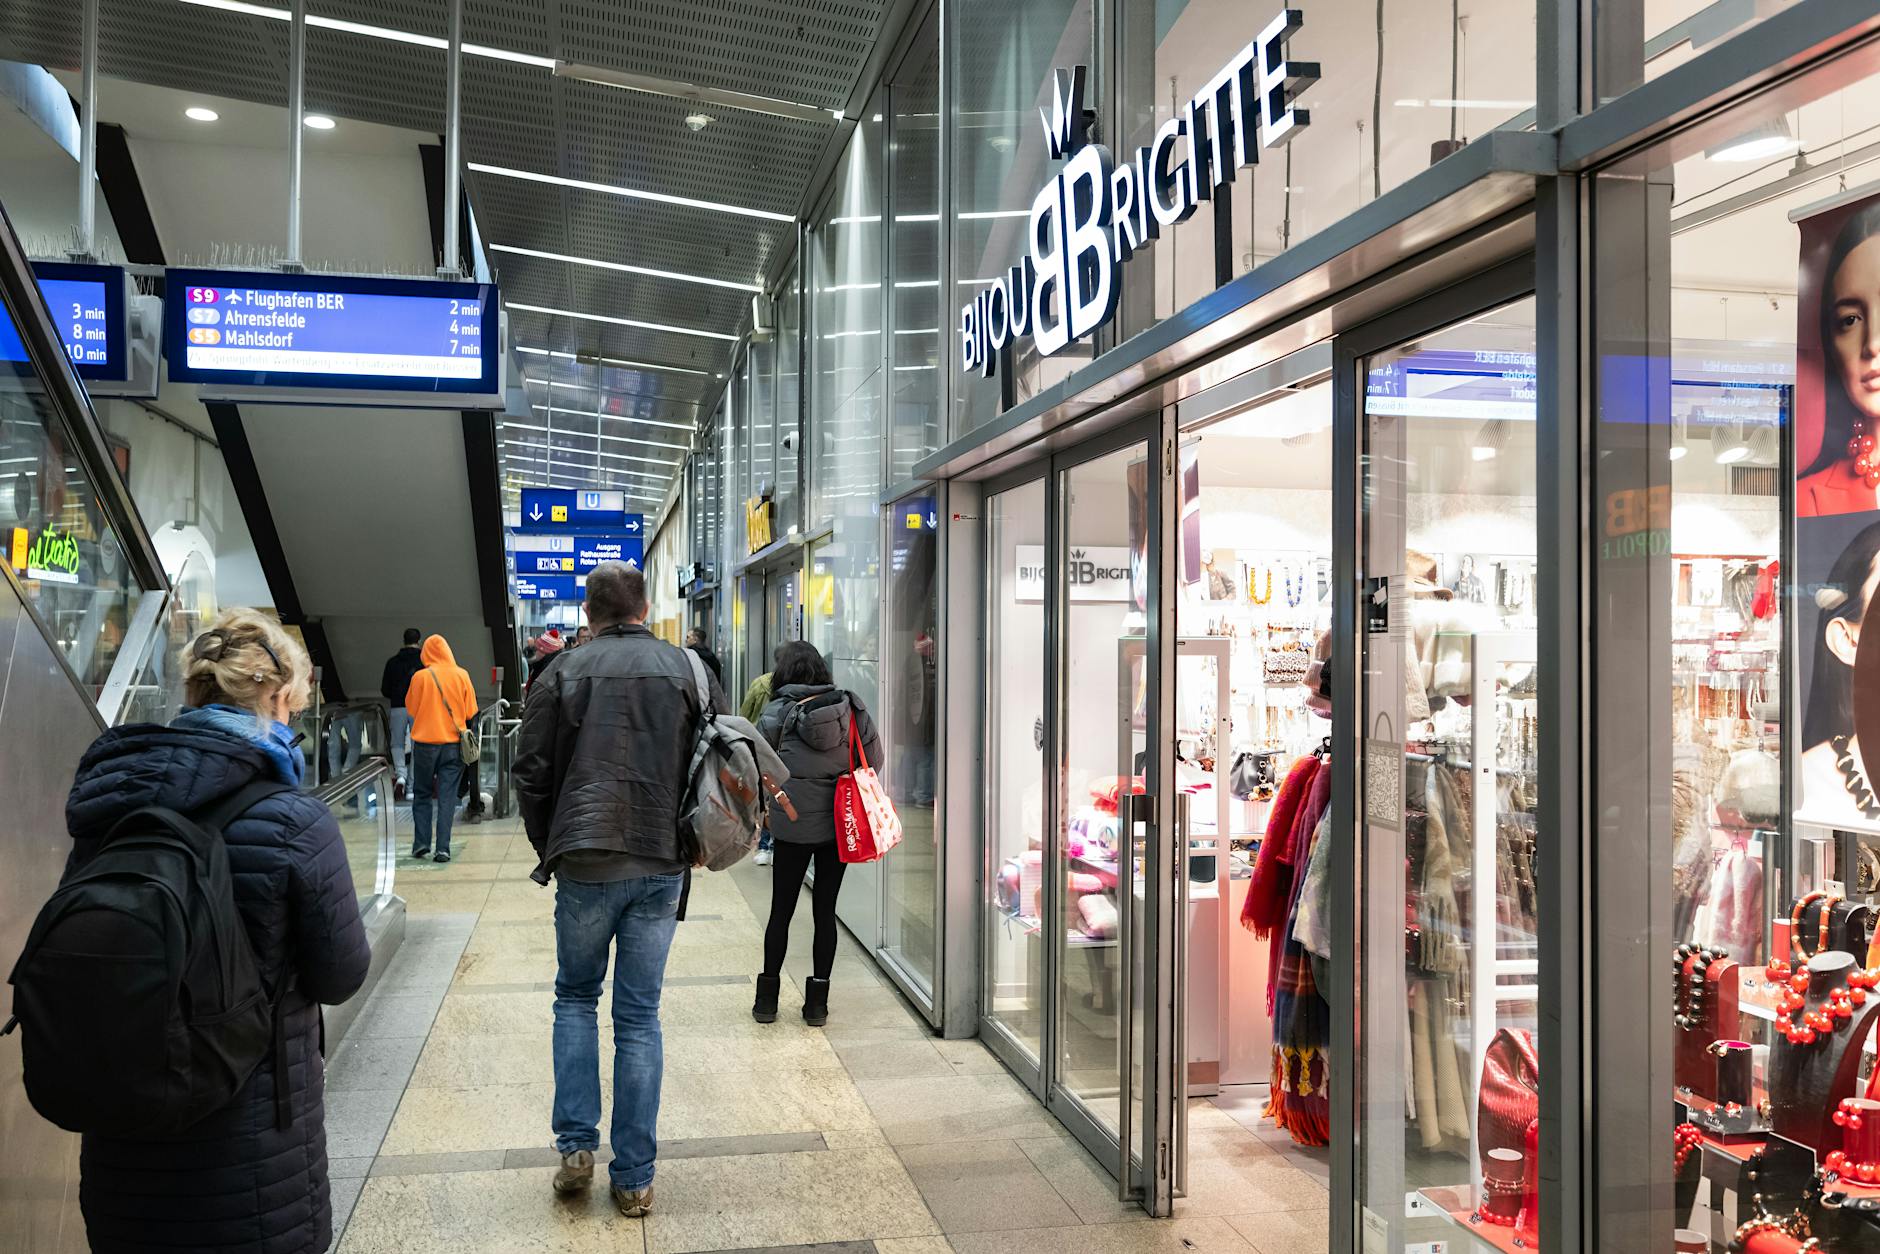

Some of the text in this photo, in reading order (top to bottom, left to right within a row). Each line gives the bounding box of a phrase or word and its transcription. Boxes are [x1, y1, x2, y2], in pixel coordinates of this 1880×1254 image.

[962, 9, 1320, 377] BIJOU BRIGITTE
[193, 288, 480, 316] S9 Flughafen BER 2 min
[72, 303, 105, 320] 3 min
[224, 309, 306, 328] Ahrensfelde
[449, 319, 459, 335] 4
[461, 324, 480, 336] min
[73, 323, 106, 340] 8 min
[225, 329, 294, 347] Mahlsdorf
[450, 339, 459, 355] 7
[461, 344, 480, 355] min
[86, 348, 107, 361] min
[588, 494, 598, 508] U
[552, 539, 560, 550] U
[596, 543, 622, 551] Ausgang
